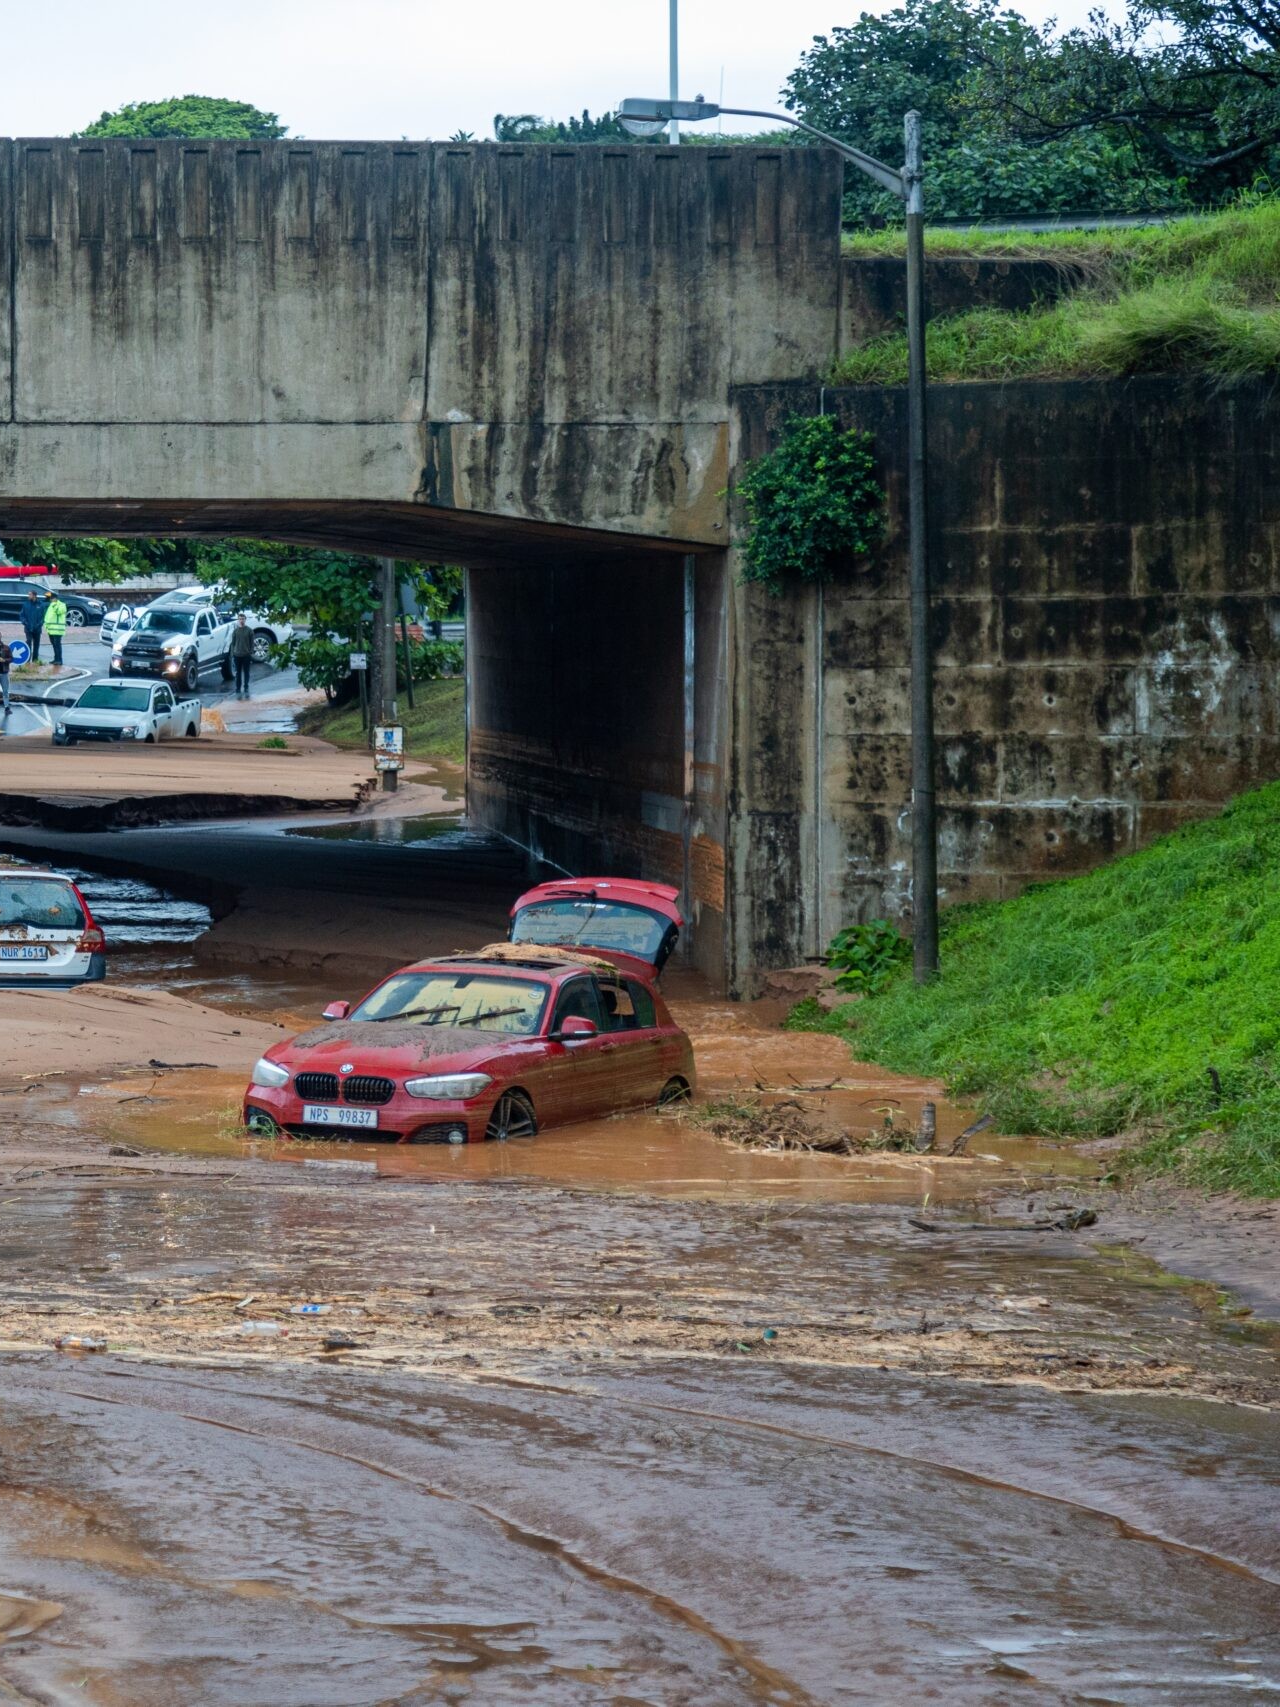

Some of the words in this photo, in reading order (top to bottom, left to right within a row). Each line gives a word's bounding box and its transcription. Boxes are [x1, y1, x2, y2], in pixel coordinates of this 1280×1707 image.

[1, 947, 19, 957] NUR
[310, 1107, 329, 1121] NPS
[339, 1109, 371, 1124] 99837
